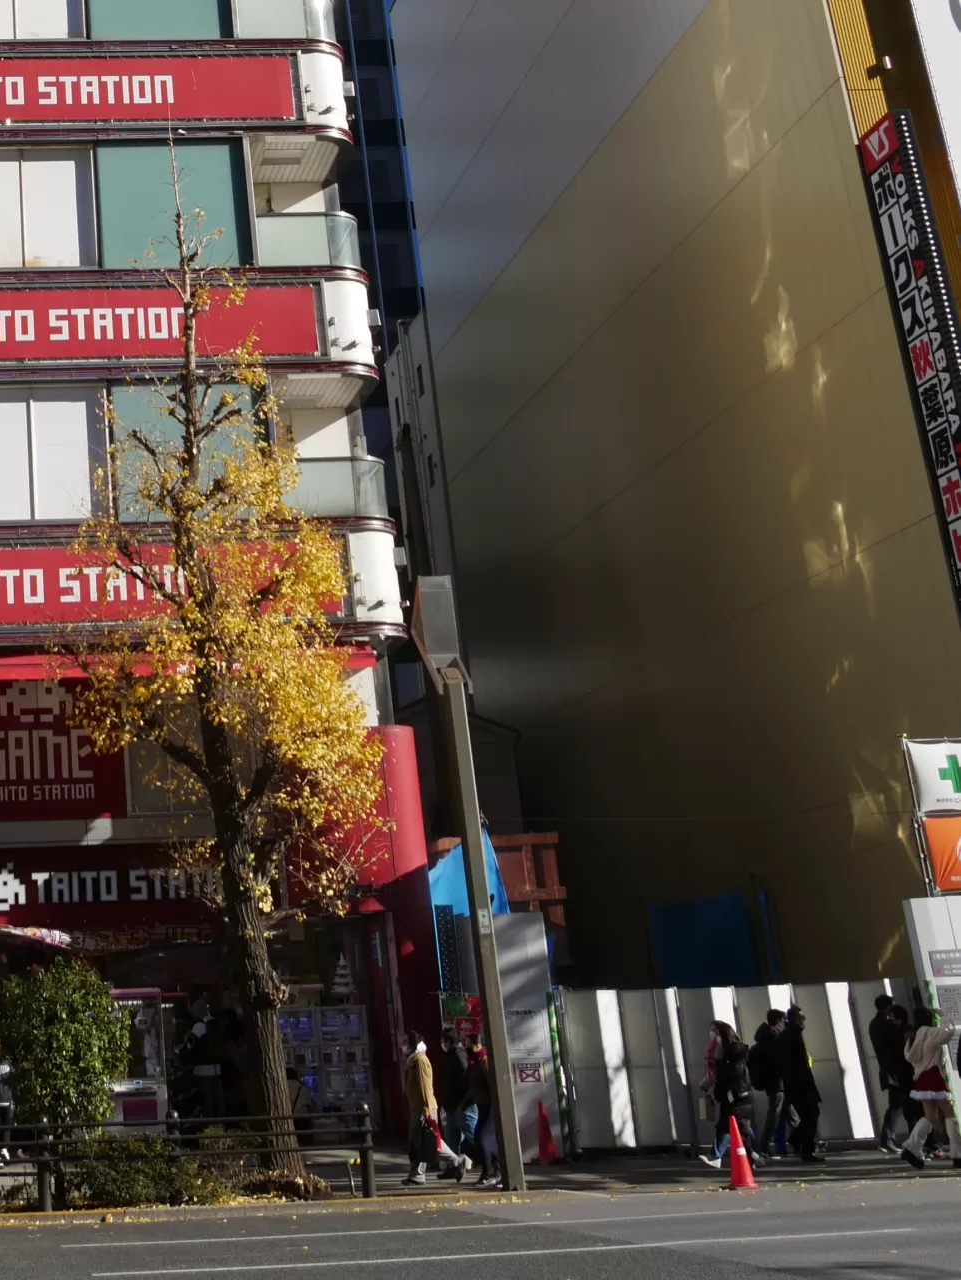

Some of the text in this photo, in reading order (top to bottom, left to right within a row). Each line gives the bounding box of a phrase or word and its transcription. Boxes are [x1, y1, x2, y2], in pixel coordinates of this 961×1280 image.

[39, 75, 175, 106] STATION
[891, 155, 919, 251] VOLKS
[59, 564, 186, 603] STATIO
[33, 783, 95, 801] STATION
[31, 870, 117, 904] TAITO
